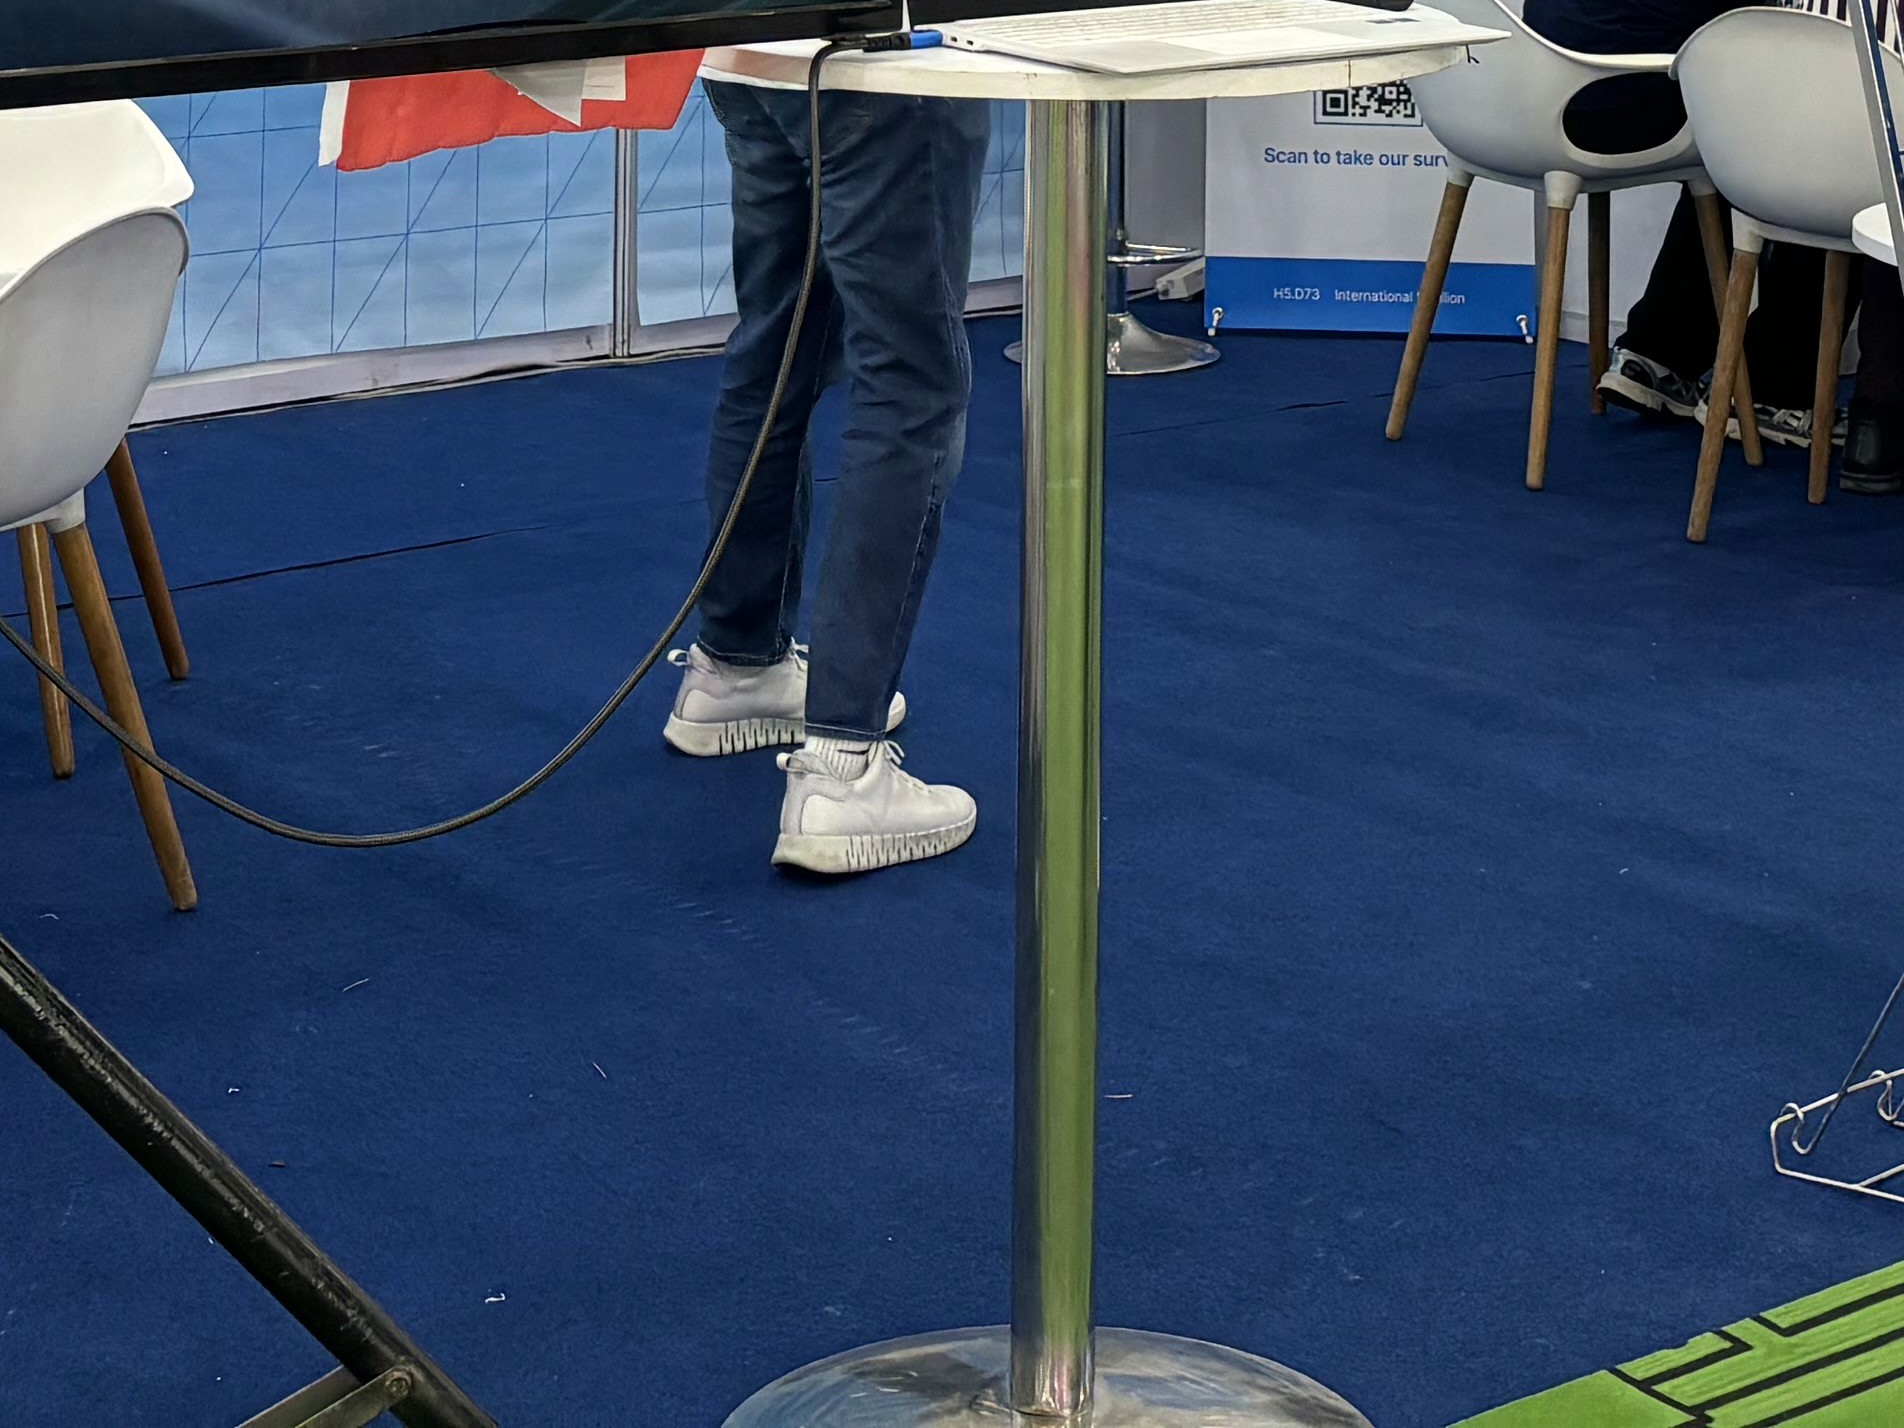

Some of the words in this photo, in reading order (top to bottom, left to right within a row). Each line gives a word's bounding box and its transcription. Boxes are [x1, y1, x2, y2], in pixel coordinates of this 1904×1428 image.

[1264, 147, 1308, 164] Scan
[1313, 149, 1331, 164] to
[1336, 149, 1374, 165] take
[1379, 153, 1409, 166] our
[1273, 287, 1321, 301] H5.D73
[1334, 289, 1413, 302] International
